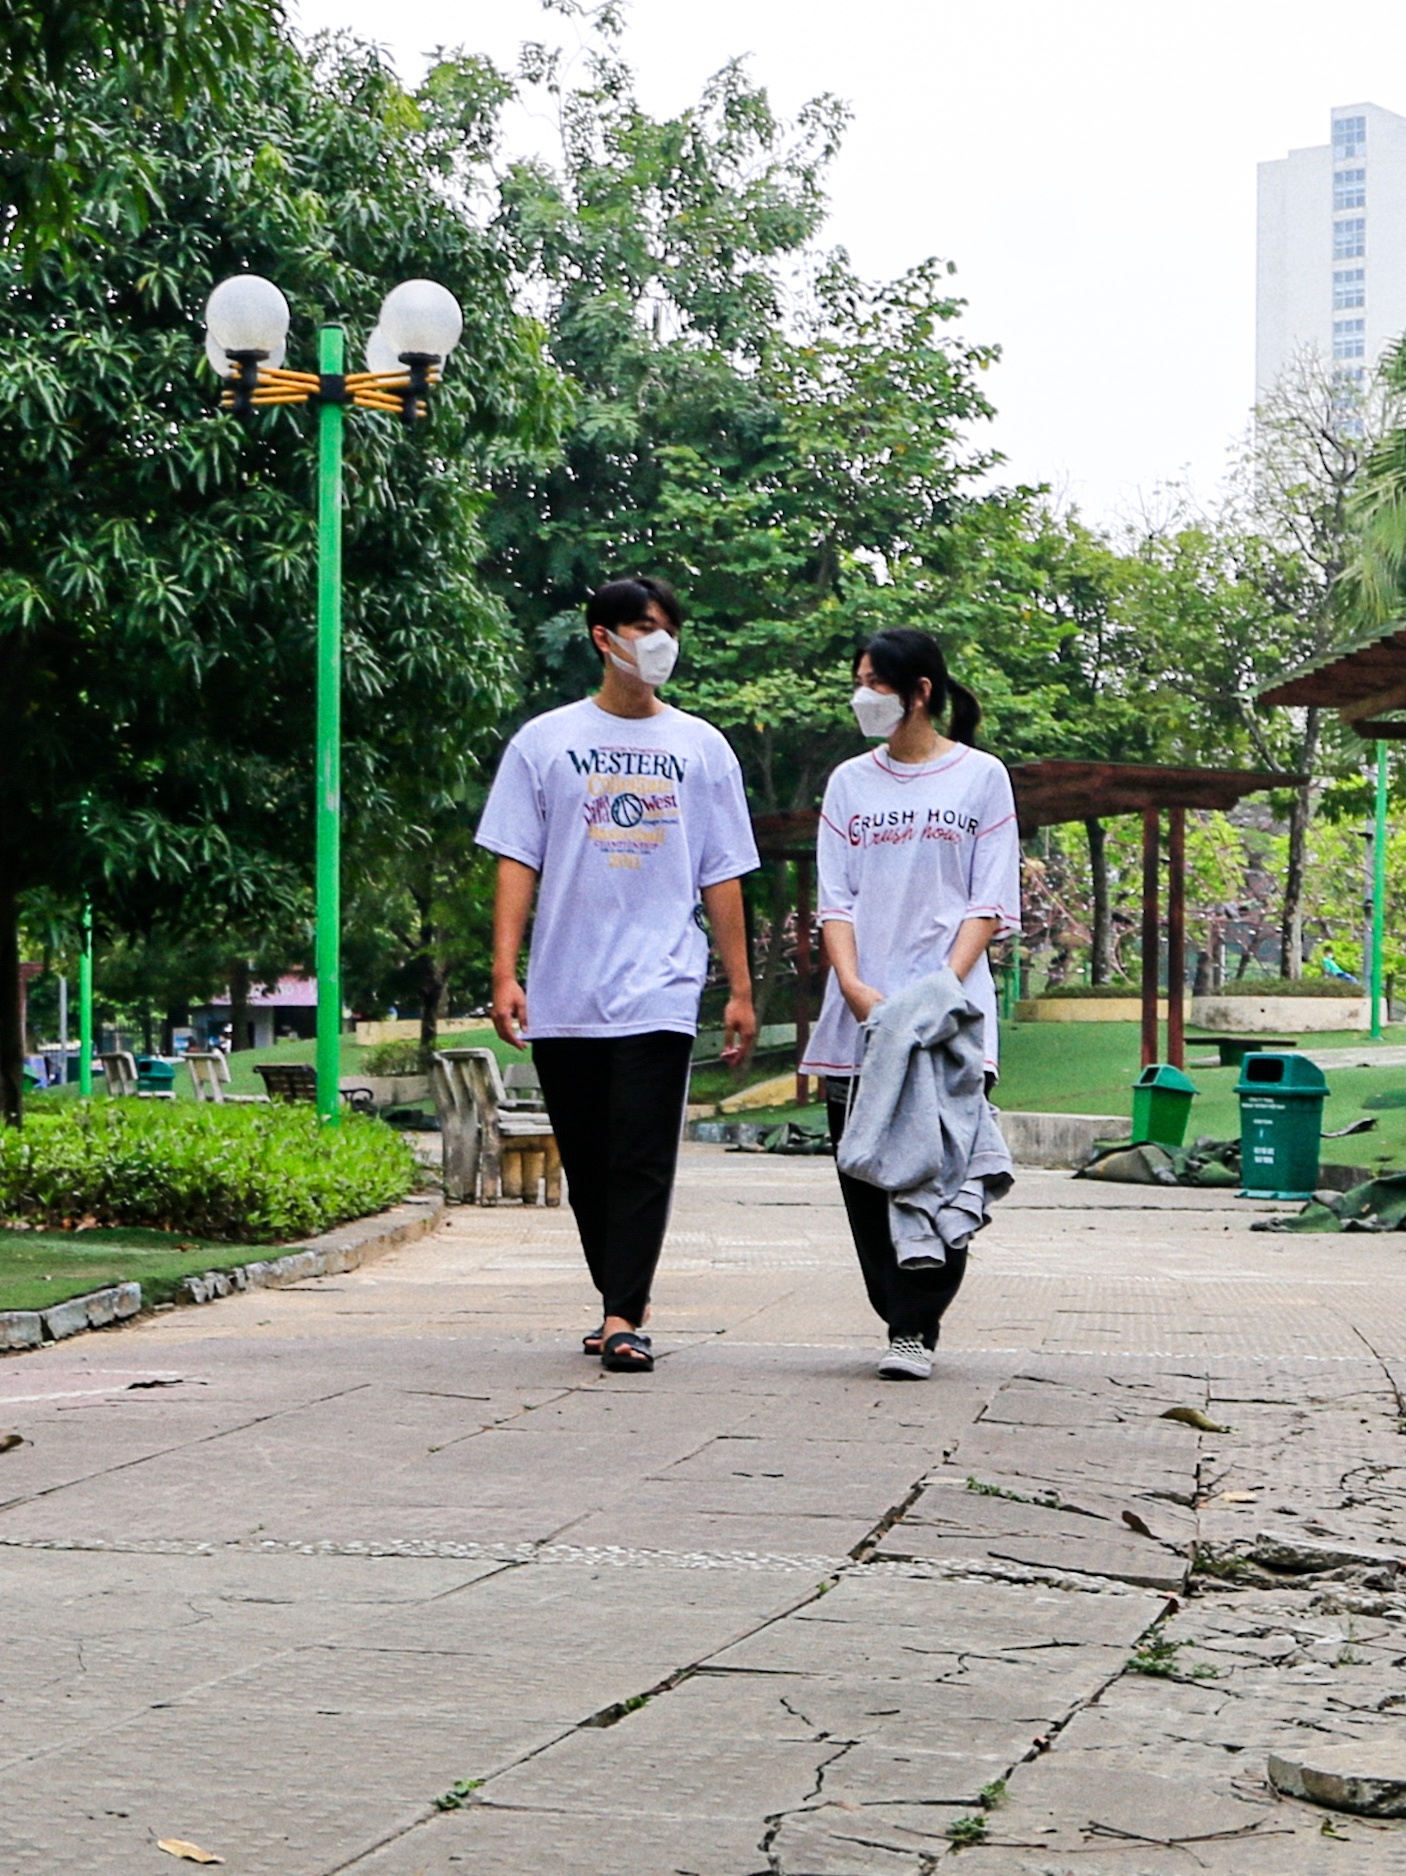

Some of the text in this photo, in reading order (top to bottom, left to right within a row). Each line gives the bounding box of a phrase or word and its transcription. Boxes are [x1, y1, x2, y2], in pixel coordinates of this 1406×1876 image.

[567, 749, 687, 783] WESTERN
[641, 795, 678, 811] West
[927, 808, 979, 836] HOUR
